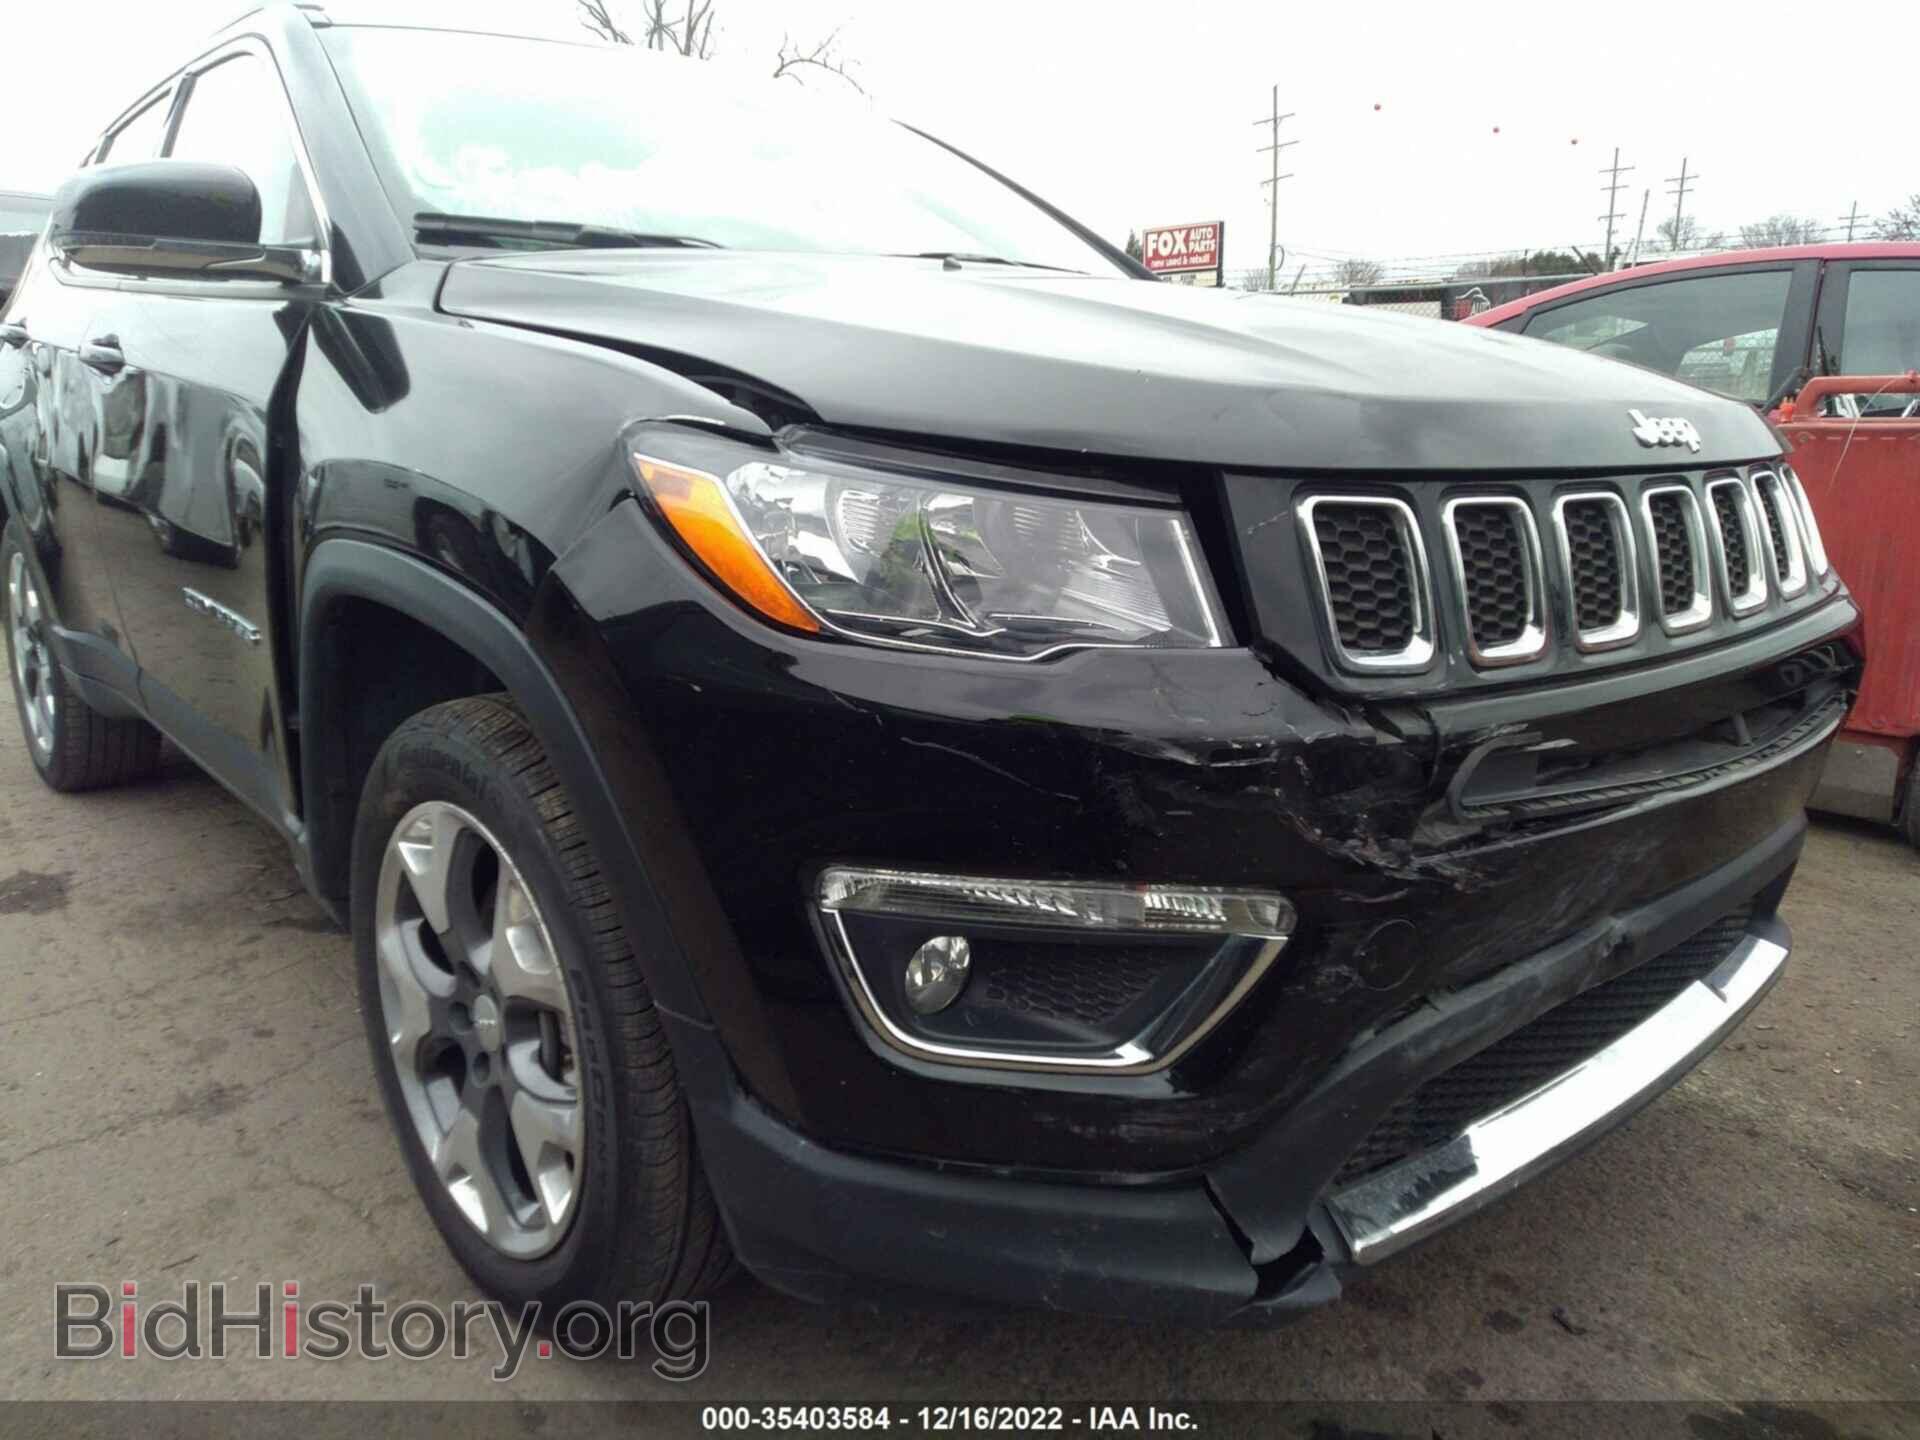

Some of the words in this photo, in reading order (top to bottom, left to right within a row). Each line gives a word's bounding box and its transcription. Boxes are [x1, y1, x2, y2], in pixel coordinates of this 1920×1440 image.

[1189, 226, 1214, 241] AUTO
[1147, 230, 1188, 257] FOX
[1189, 239, 1216, 253] PARTS
[1166, 256, 1182, 267] used
[1627, 408, 1701, 453] Jeep
